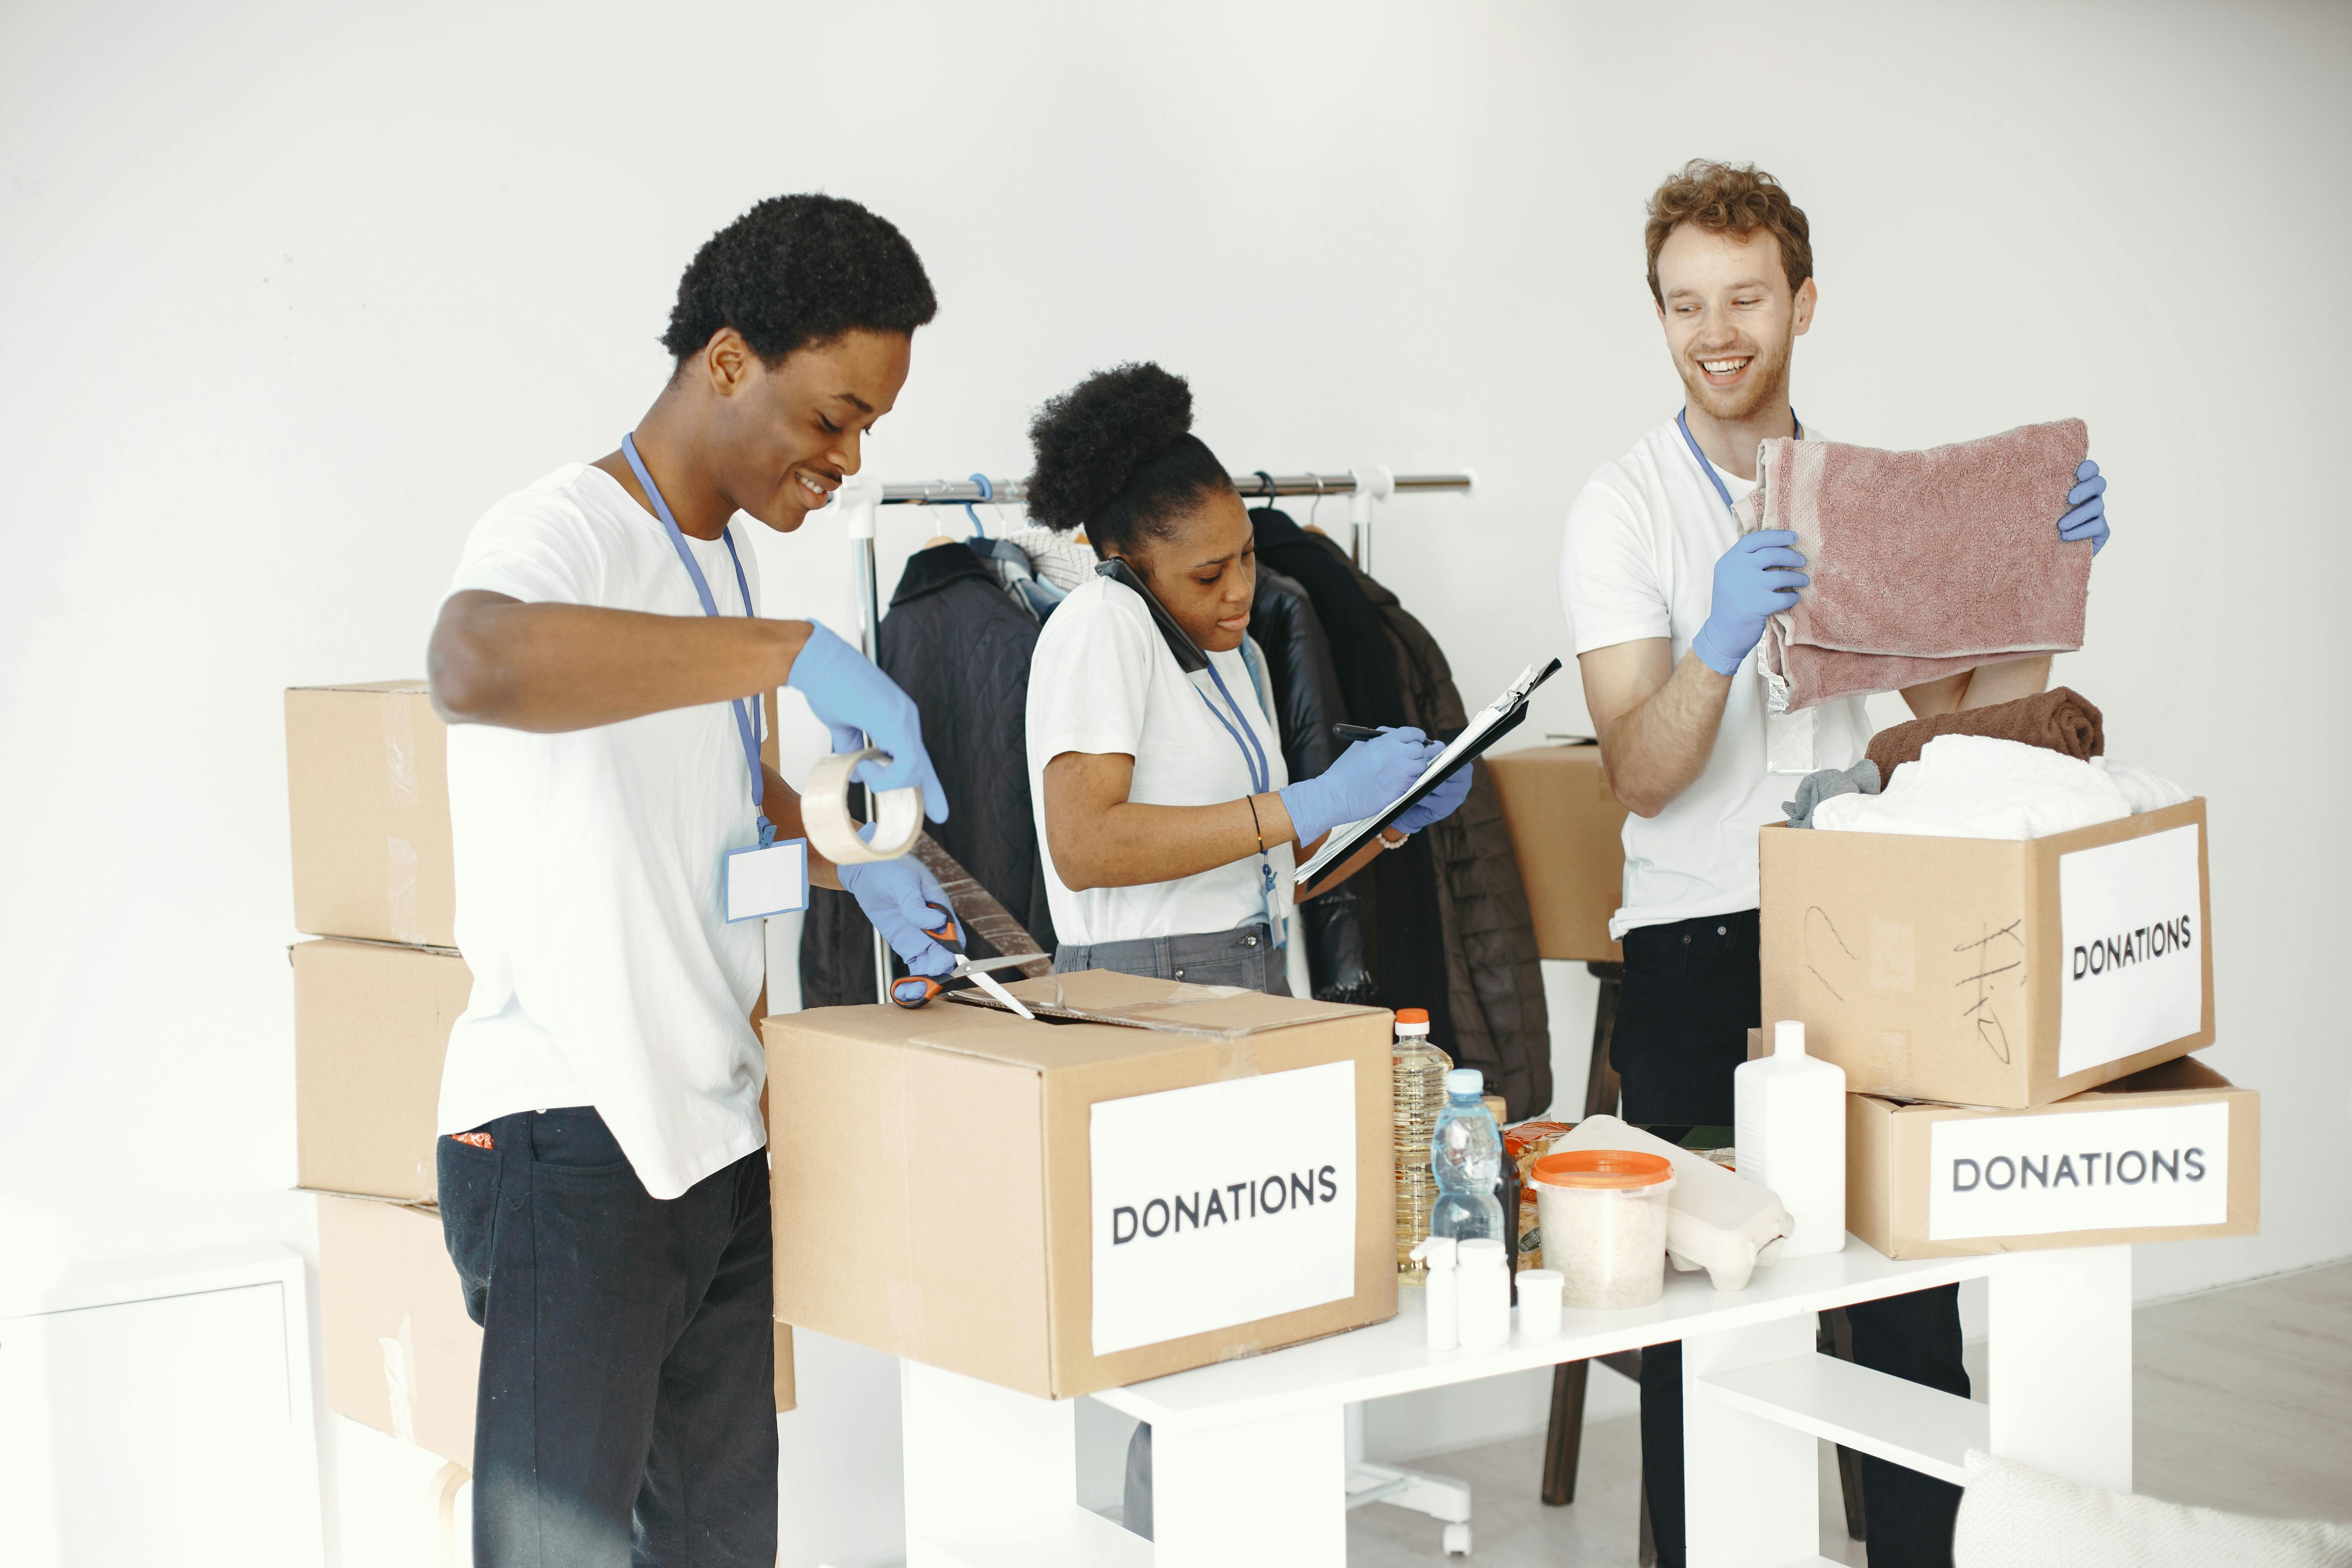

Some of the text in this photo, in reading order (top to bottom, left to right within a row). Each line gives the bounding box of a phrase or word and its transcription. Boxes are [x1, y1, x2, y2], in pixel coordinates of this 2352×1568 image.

[2074, 915, 2191, 981] DONATIONS
[1953, 1148, 2205, 1192] DONATIONS
[1114, 1165, 1337, 1245] DONATIONS
